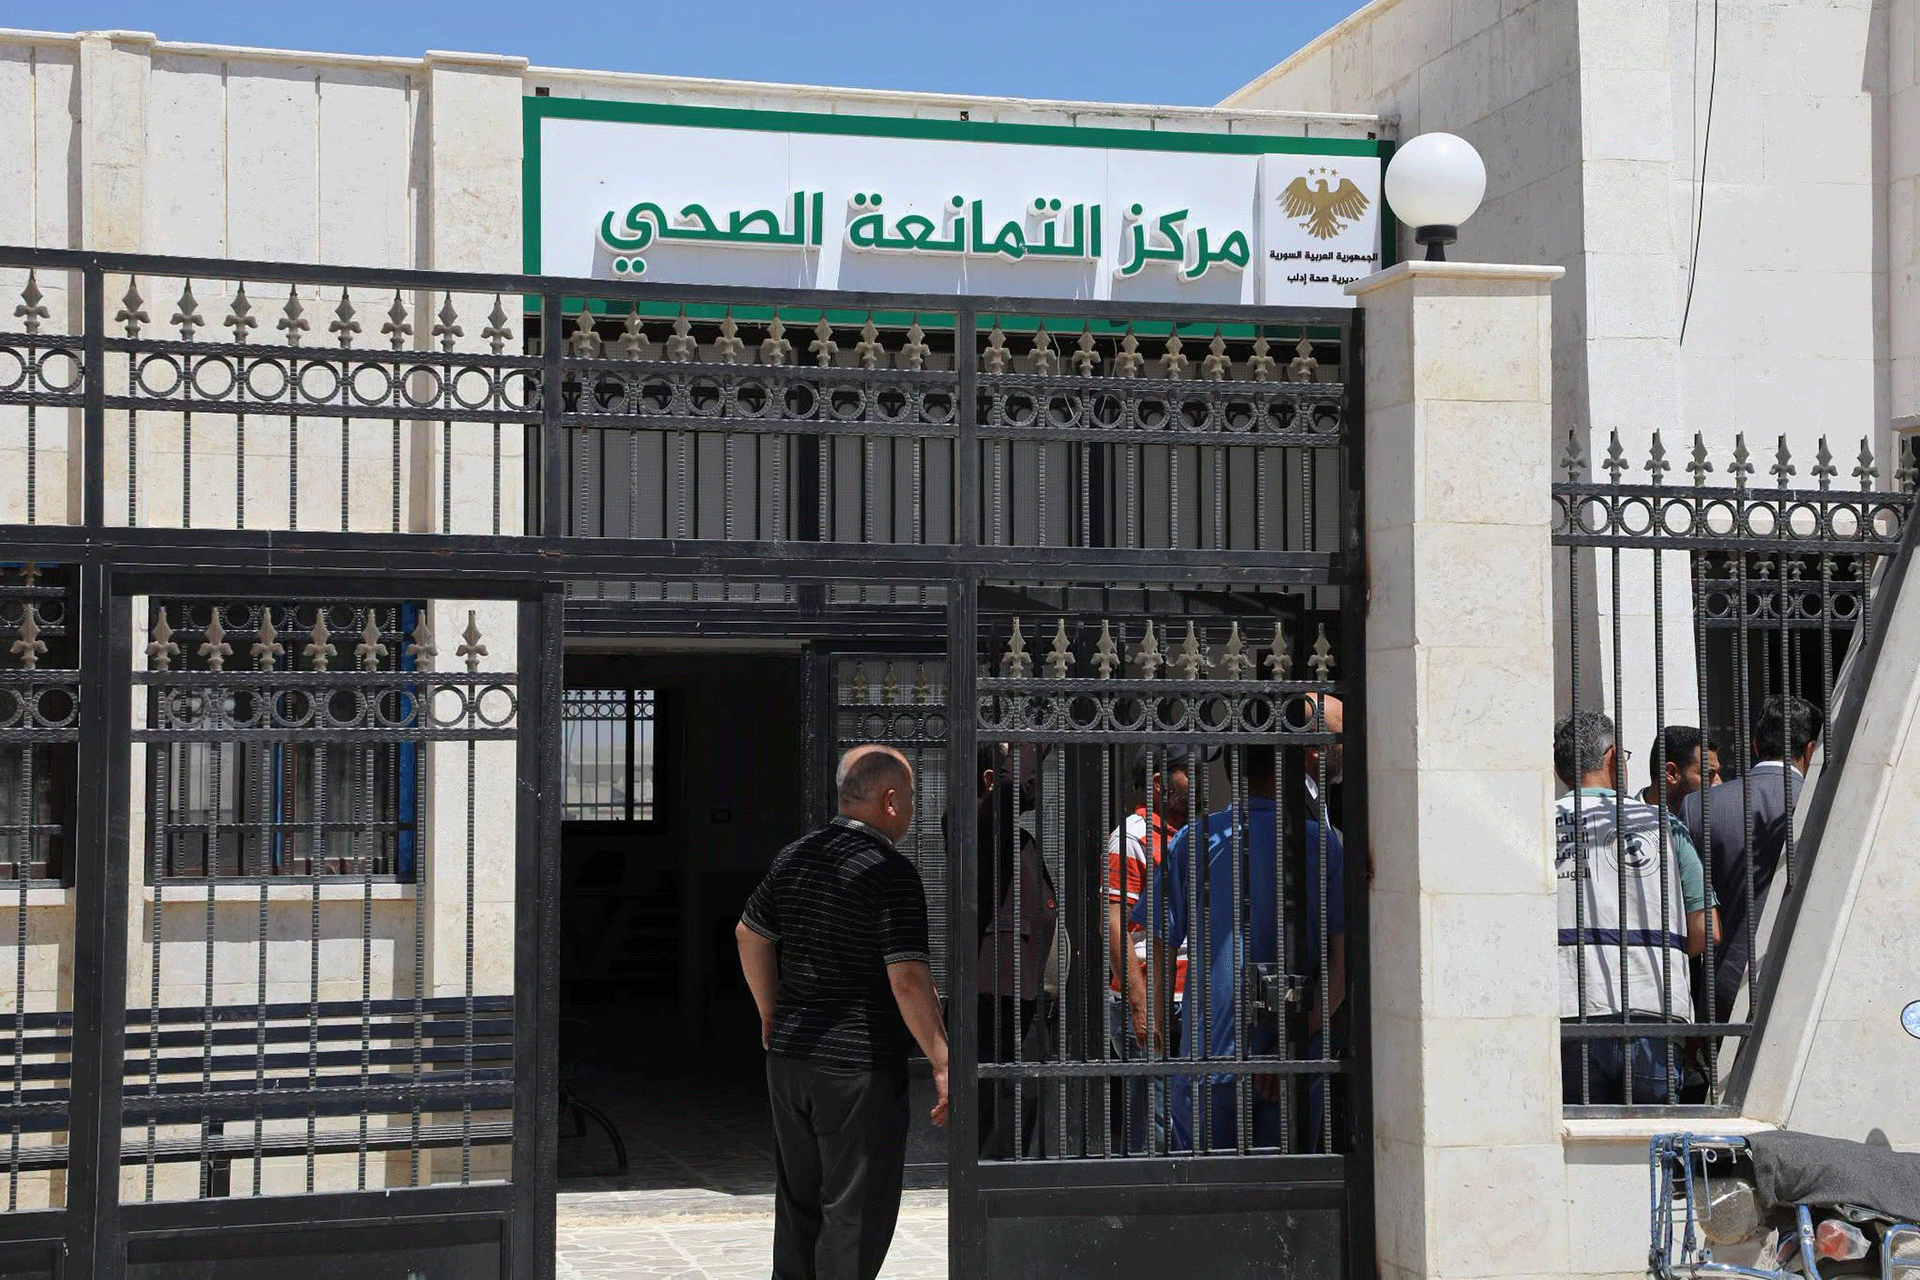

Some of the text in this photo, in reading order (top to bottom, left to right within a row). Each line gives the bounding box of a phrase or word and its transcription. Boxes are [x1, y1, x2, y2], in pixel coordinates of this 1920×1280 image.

[601, 192, 1249, 277] مركز التمانعة الصحي
[1269, 250, 1378, 263] الجمهورية العربية السورية
[1287, 273, 1307, 285] إدلب
[1309, 273, 1329, 282] صحة
